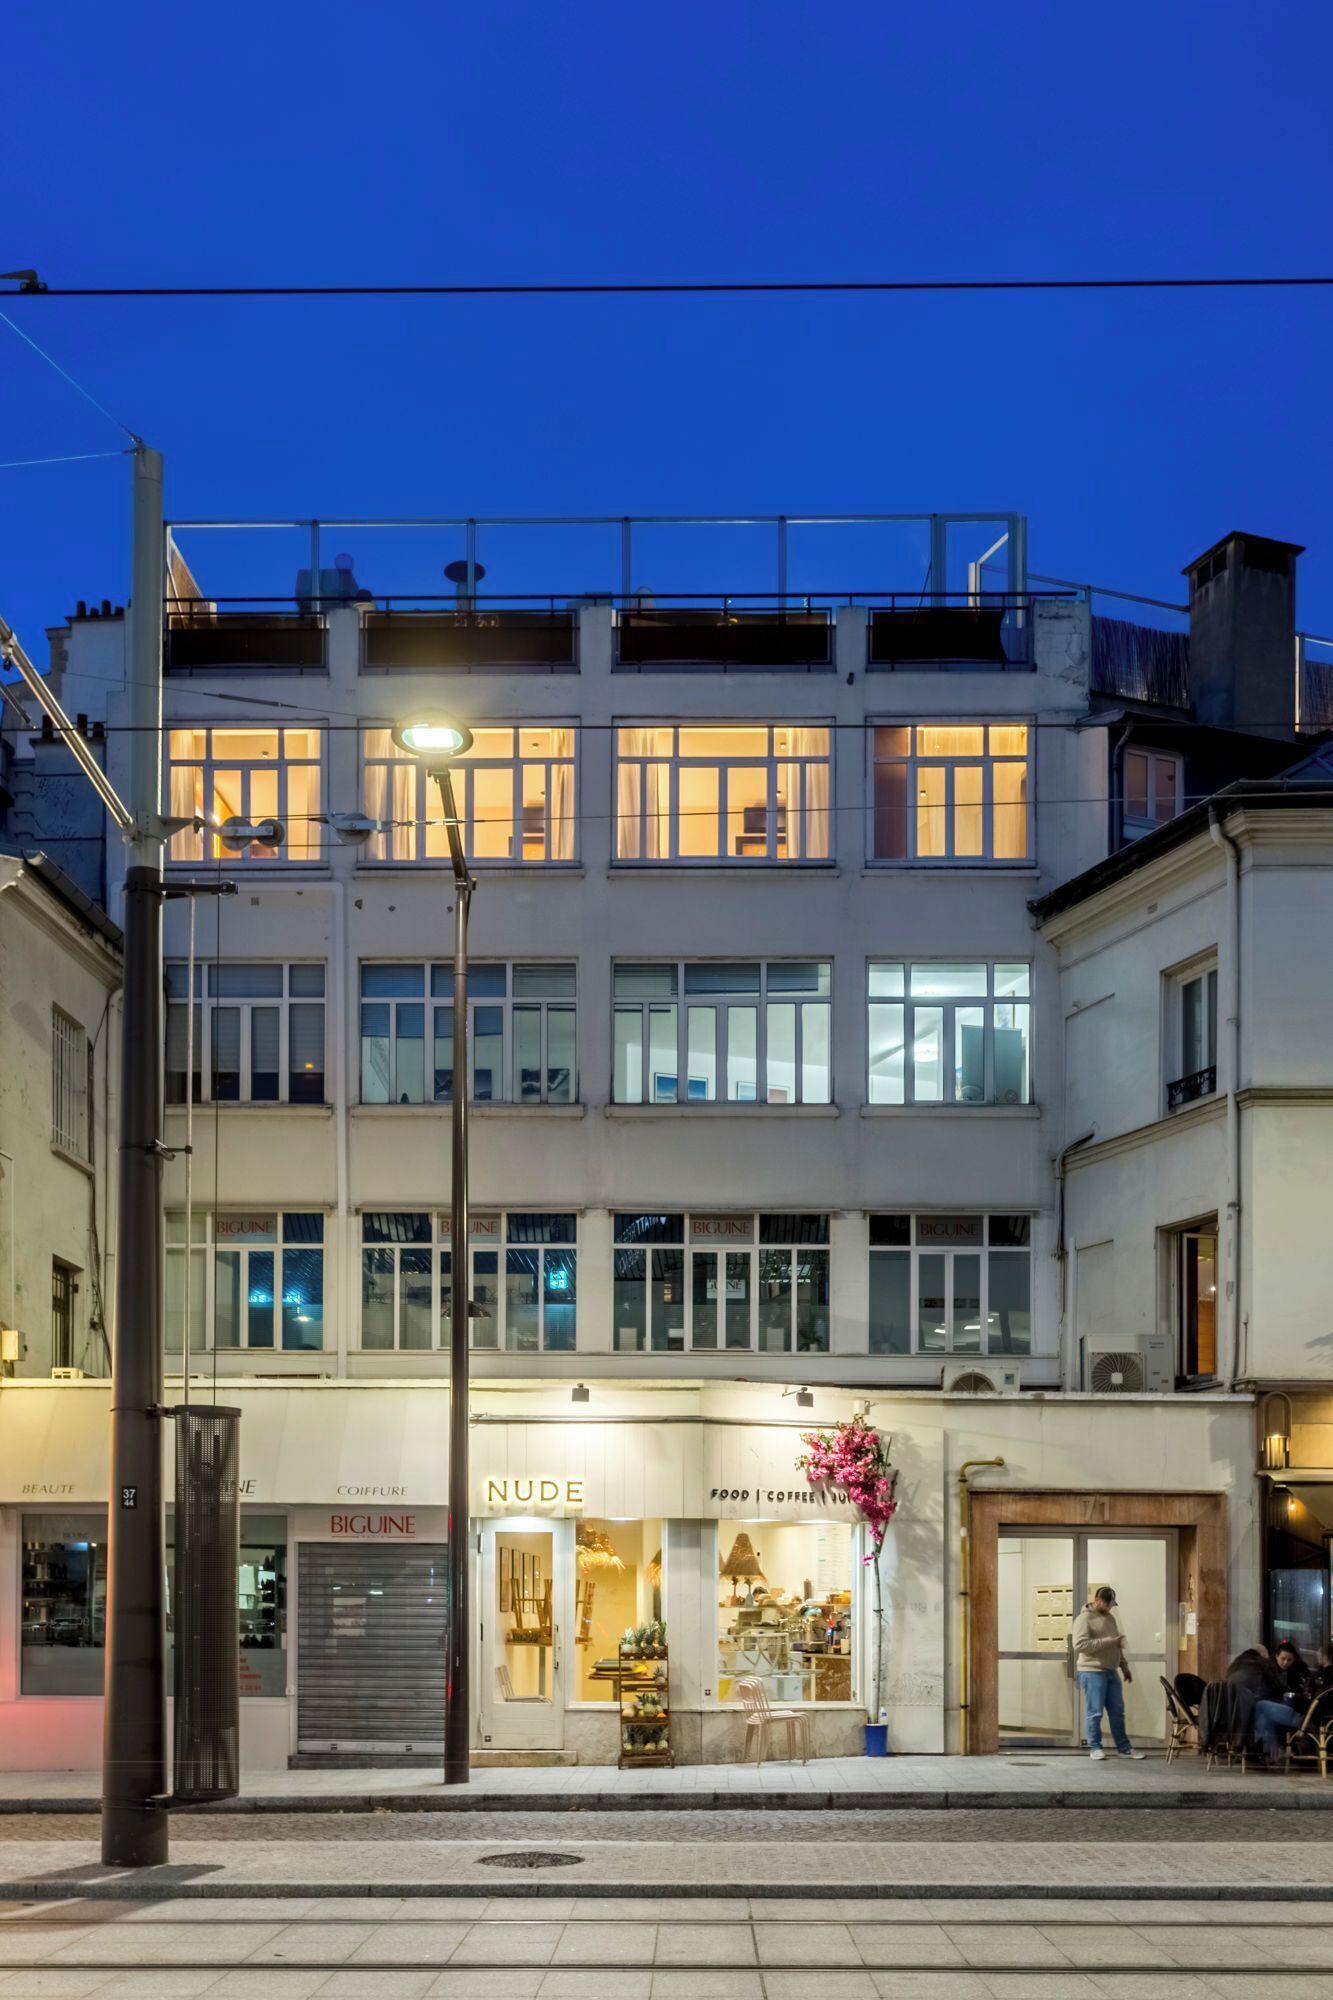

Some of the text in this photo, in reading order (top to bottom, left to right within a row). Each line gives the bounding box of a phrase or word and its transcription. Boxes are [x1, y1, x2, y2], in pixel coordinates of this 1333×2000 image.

[216, 1220, 273, 1234] BIGUINE
[693, 1221, 748, 1234] BIGUINE
[920, 1223, 977, 1236] BIGUINE
[22, 1485, 76, 1497] BEAUTE
[122, 1488, 136, 1499] 37
[336, 1486, 408, 1496] COIFFURE
[488, 1480, 583, 1503] NUDE
[711, 1488, 750, 1502] FOOD
[766, 1490, 816, 1504] COFFEE
[123, 1499, 134, 1507] 44
[1079, 1496, 1110, 1521] 71
[331, 1515, 416, 1534] BIGUINE
